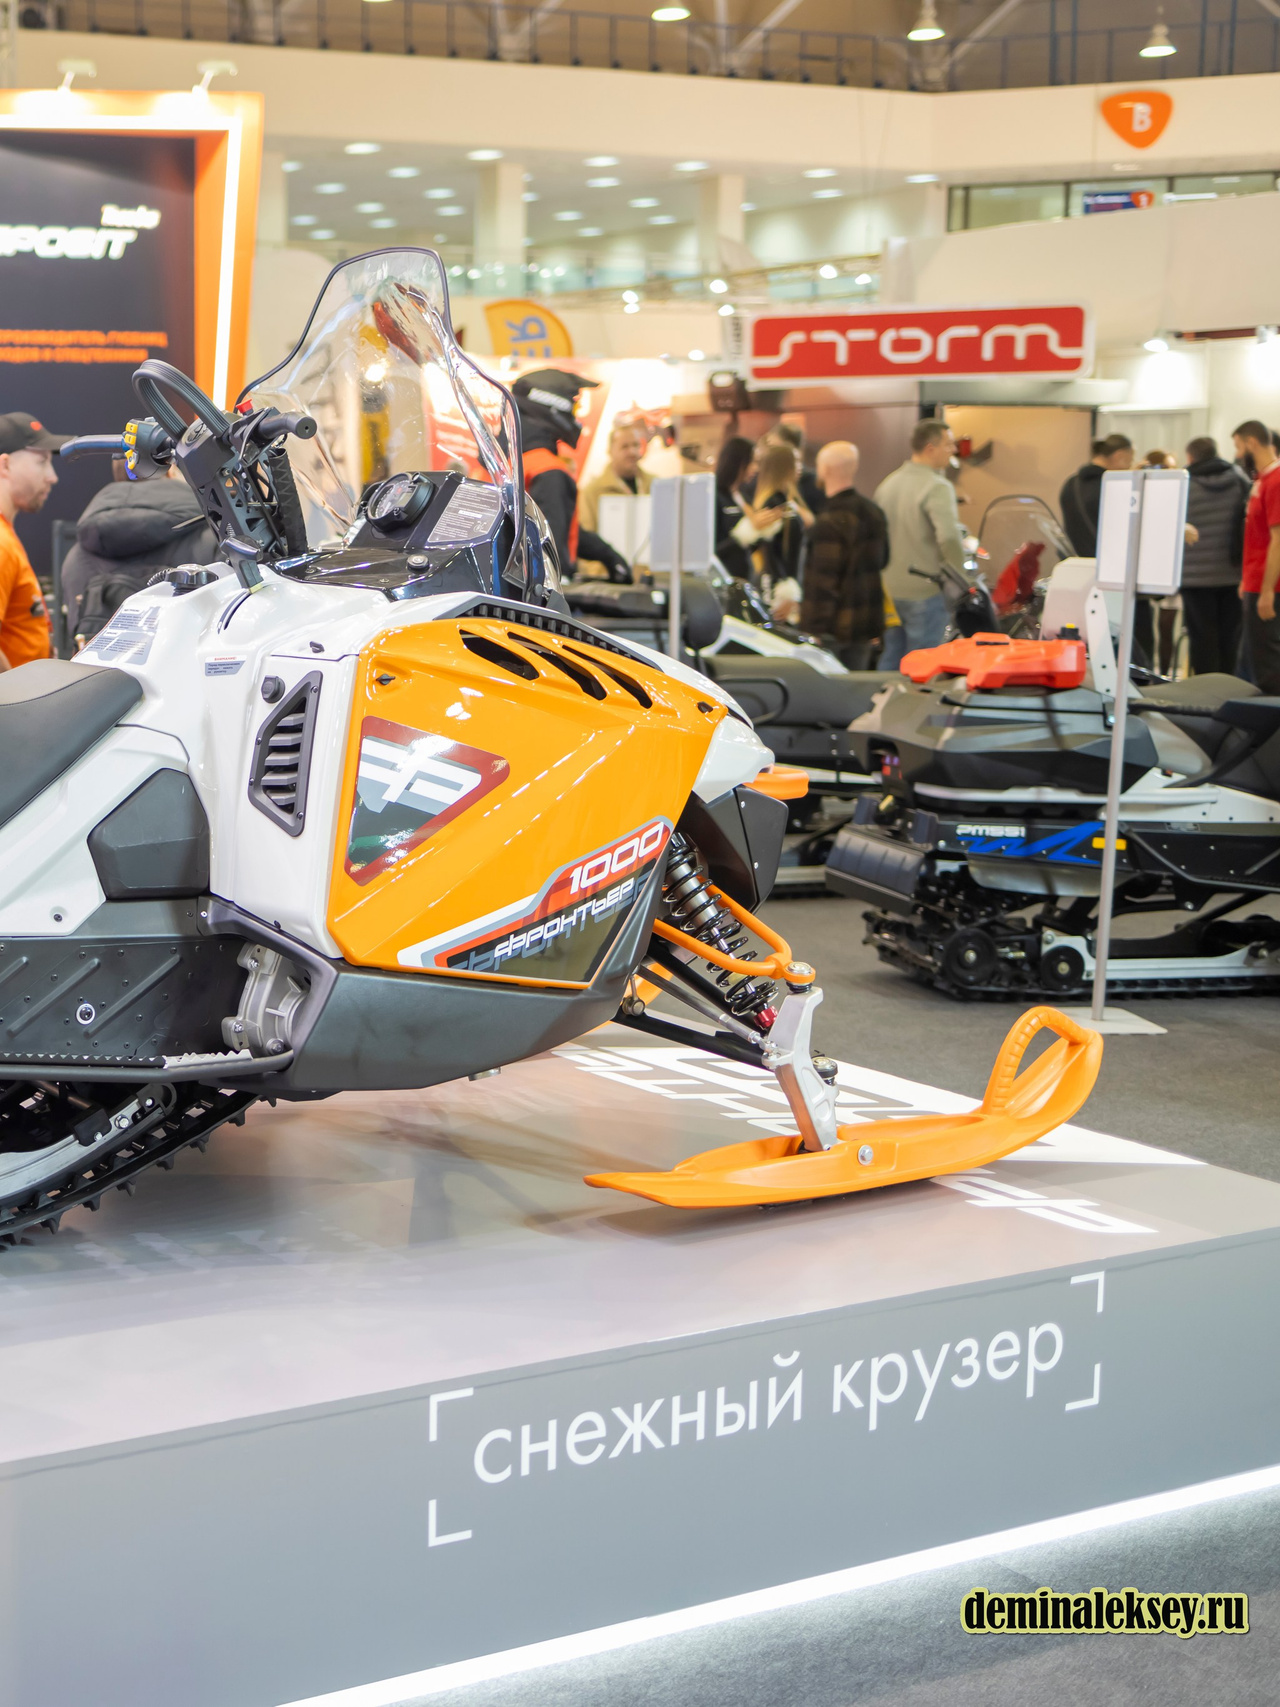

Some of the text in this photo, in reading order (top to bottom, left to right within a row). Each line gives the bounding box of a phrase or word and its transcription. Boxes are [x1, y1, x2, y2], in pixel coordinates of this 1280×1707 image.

[568, 820, 668, 894] 1000
[472, 1320, 1065, 1485] снежный крузер
